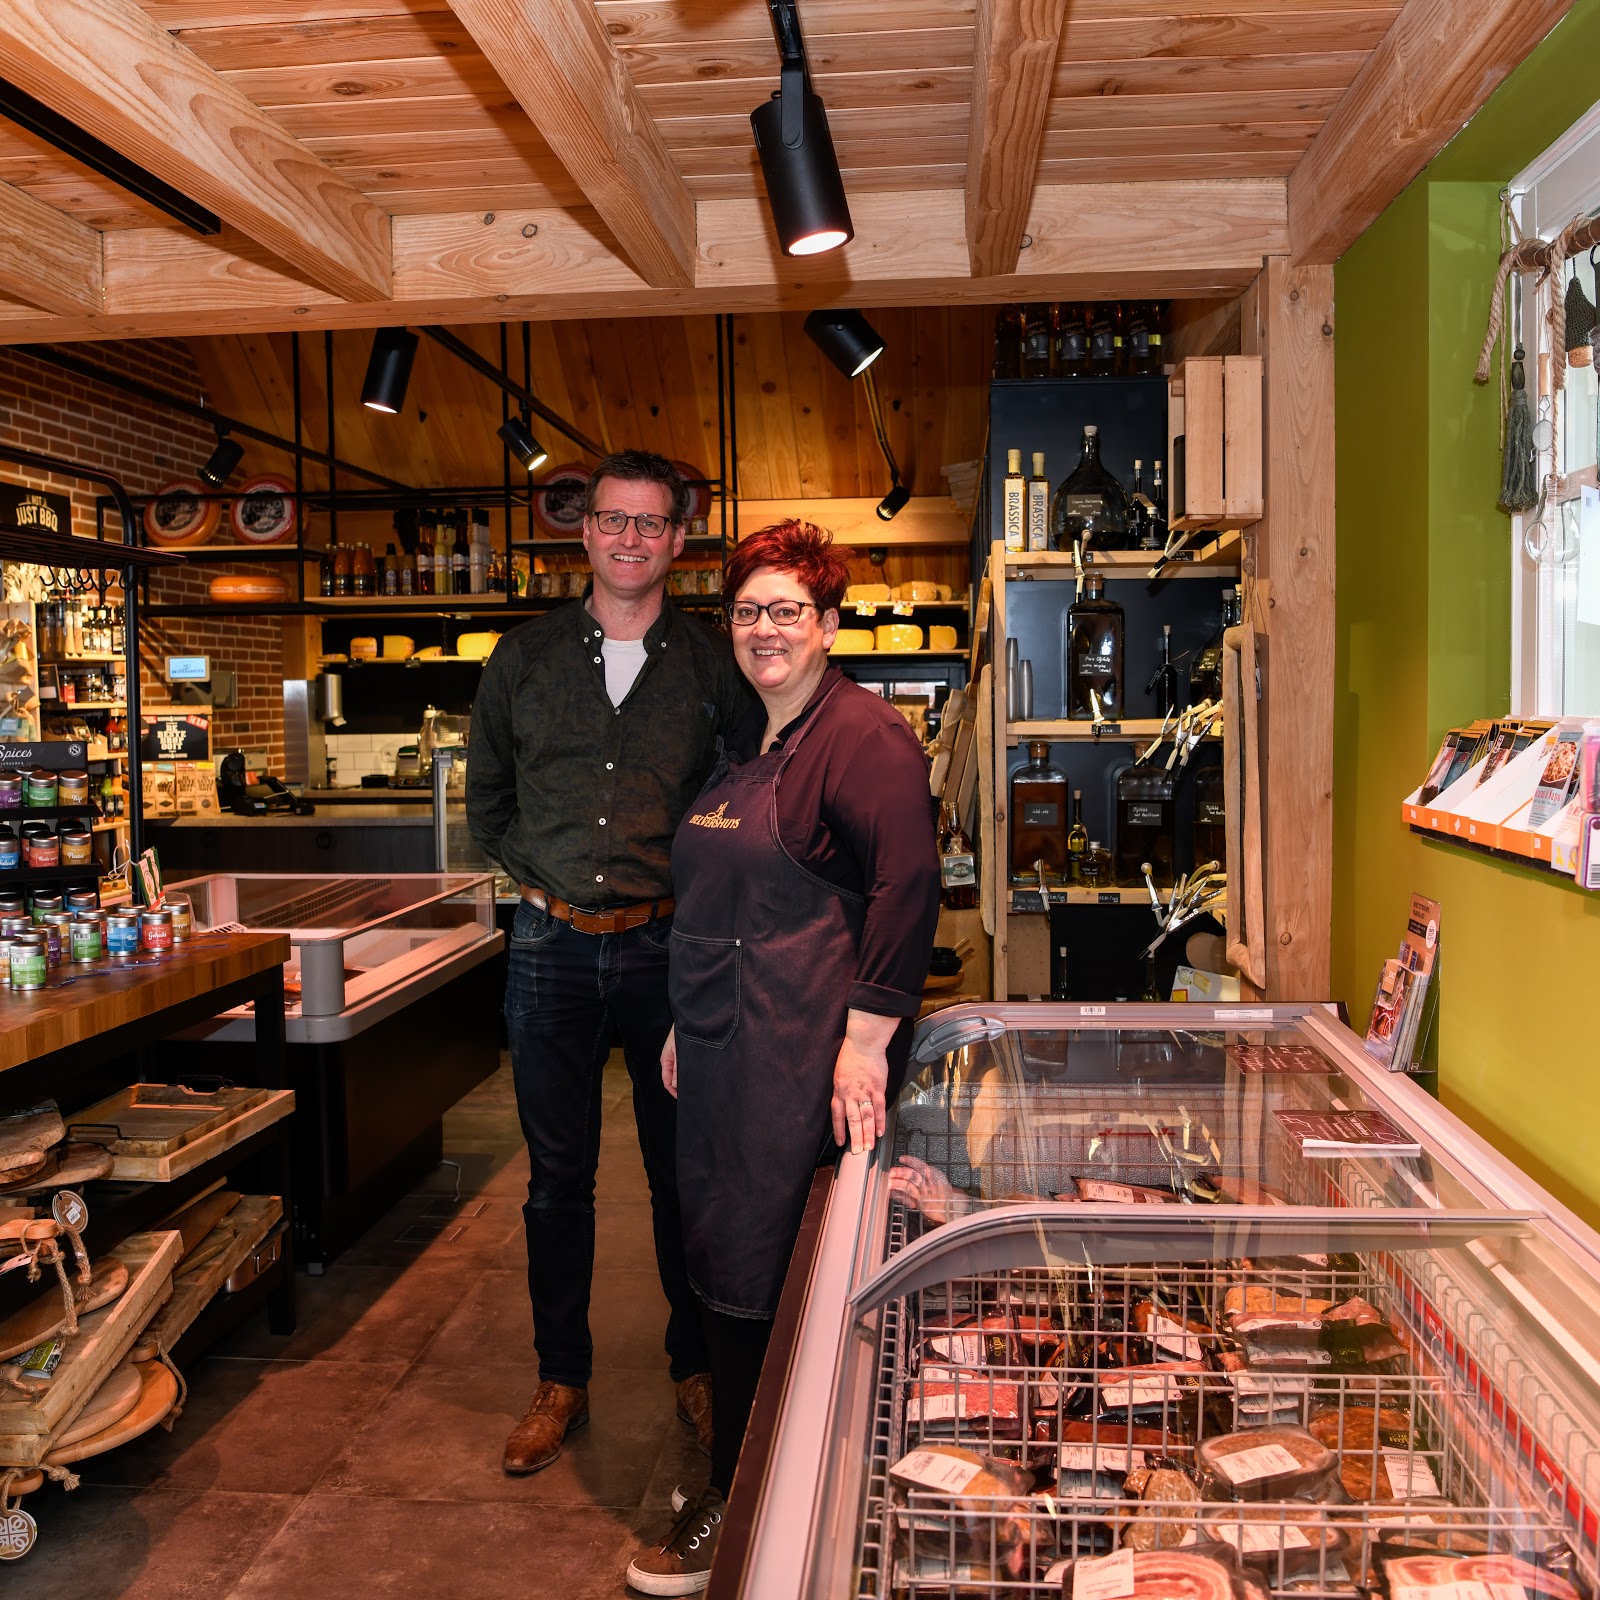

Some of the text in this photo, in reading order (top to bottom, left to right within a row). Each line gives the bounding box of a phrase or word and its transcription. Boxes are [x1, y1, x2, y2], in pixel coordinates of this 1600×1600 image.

[16, 505, 58, 533] JUST BBQ
[1008, 492, 1020, 538] BRASSICA
[1032, 494, 1044, 540] BRASSICA
[157, 730, 187, 739] BESTE
[0, 744, 33, 762] Spices
[71, 794, 83, 803] Kip
